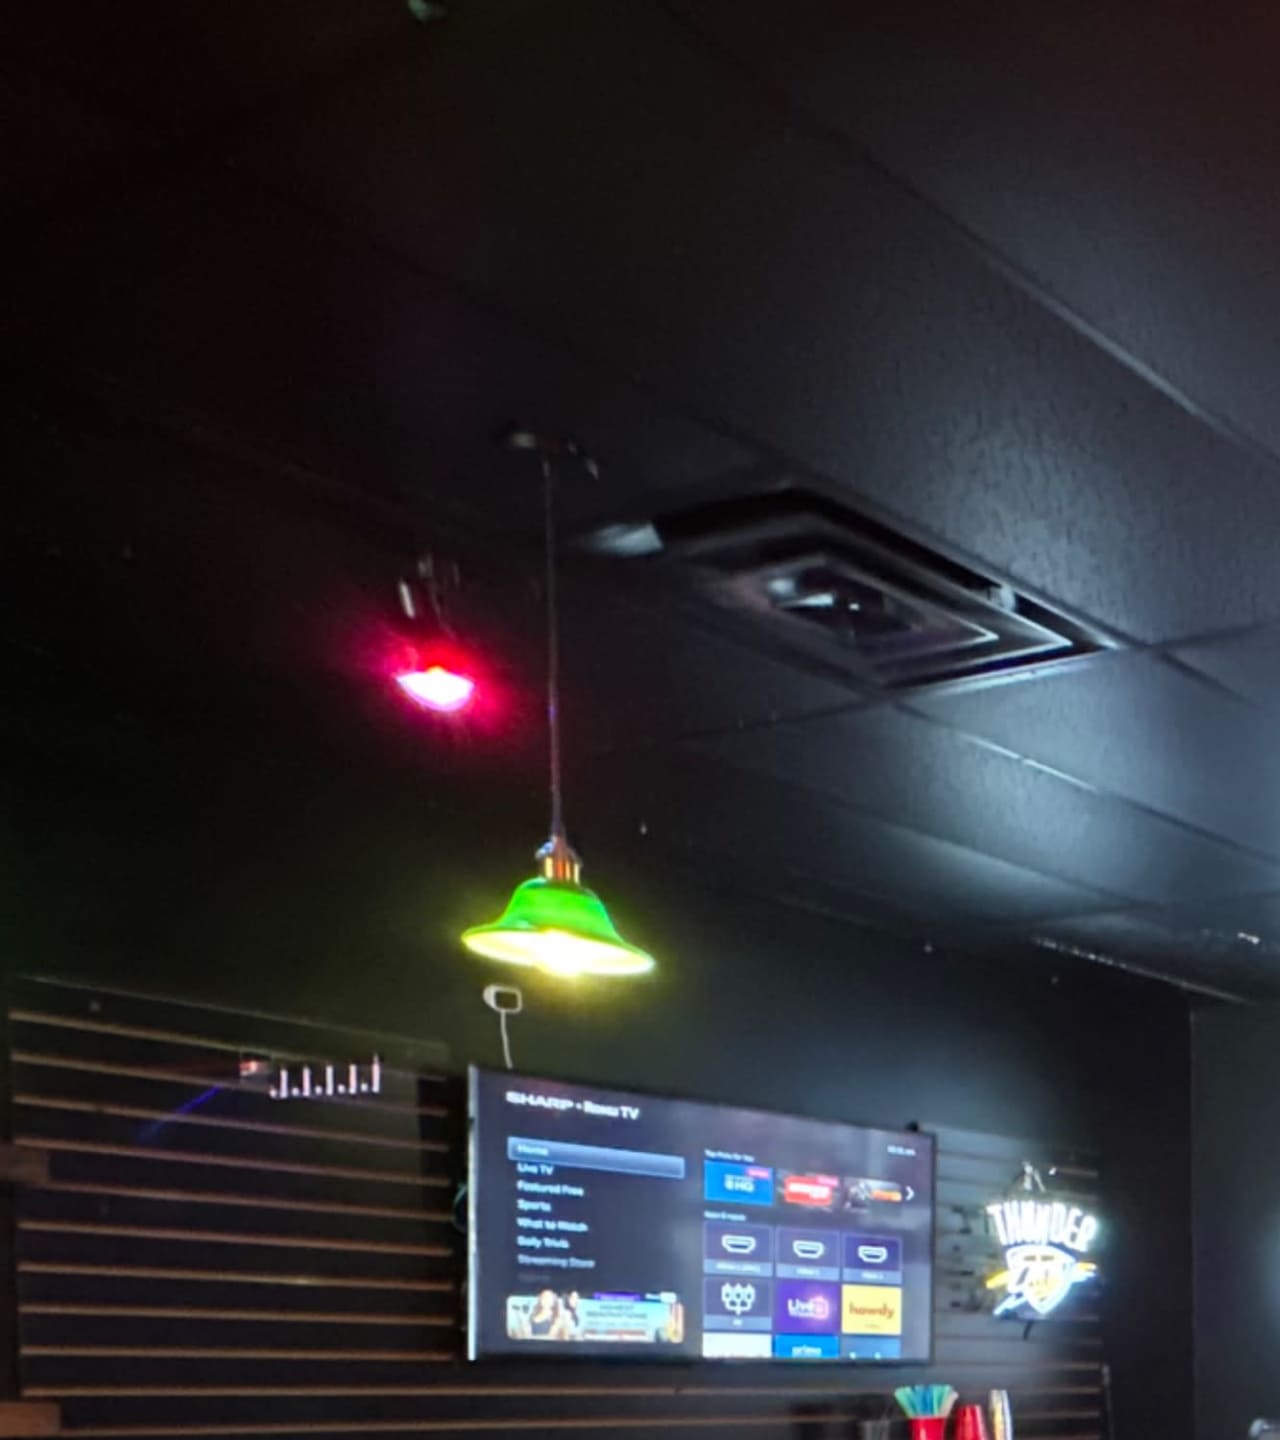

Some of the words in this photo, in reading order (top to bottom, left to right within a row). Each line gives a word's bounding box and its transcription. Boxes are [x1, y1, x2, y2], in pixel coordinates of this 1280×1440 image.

[505, 1091, 574, 1110] SHARP
[620, 1105, 640, 1120] TV
[986, 1200, 1097, 1252] THUNDER
